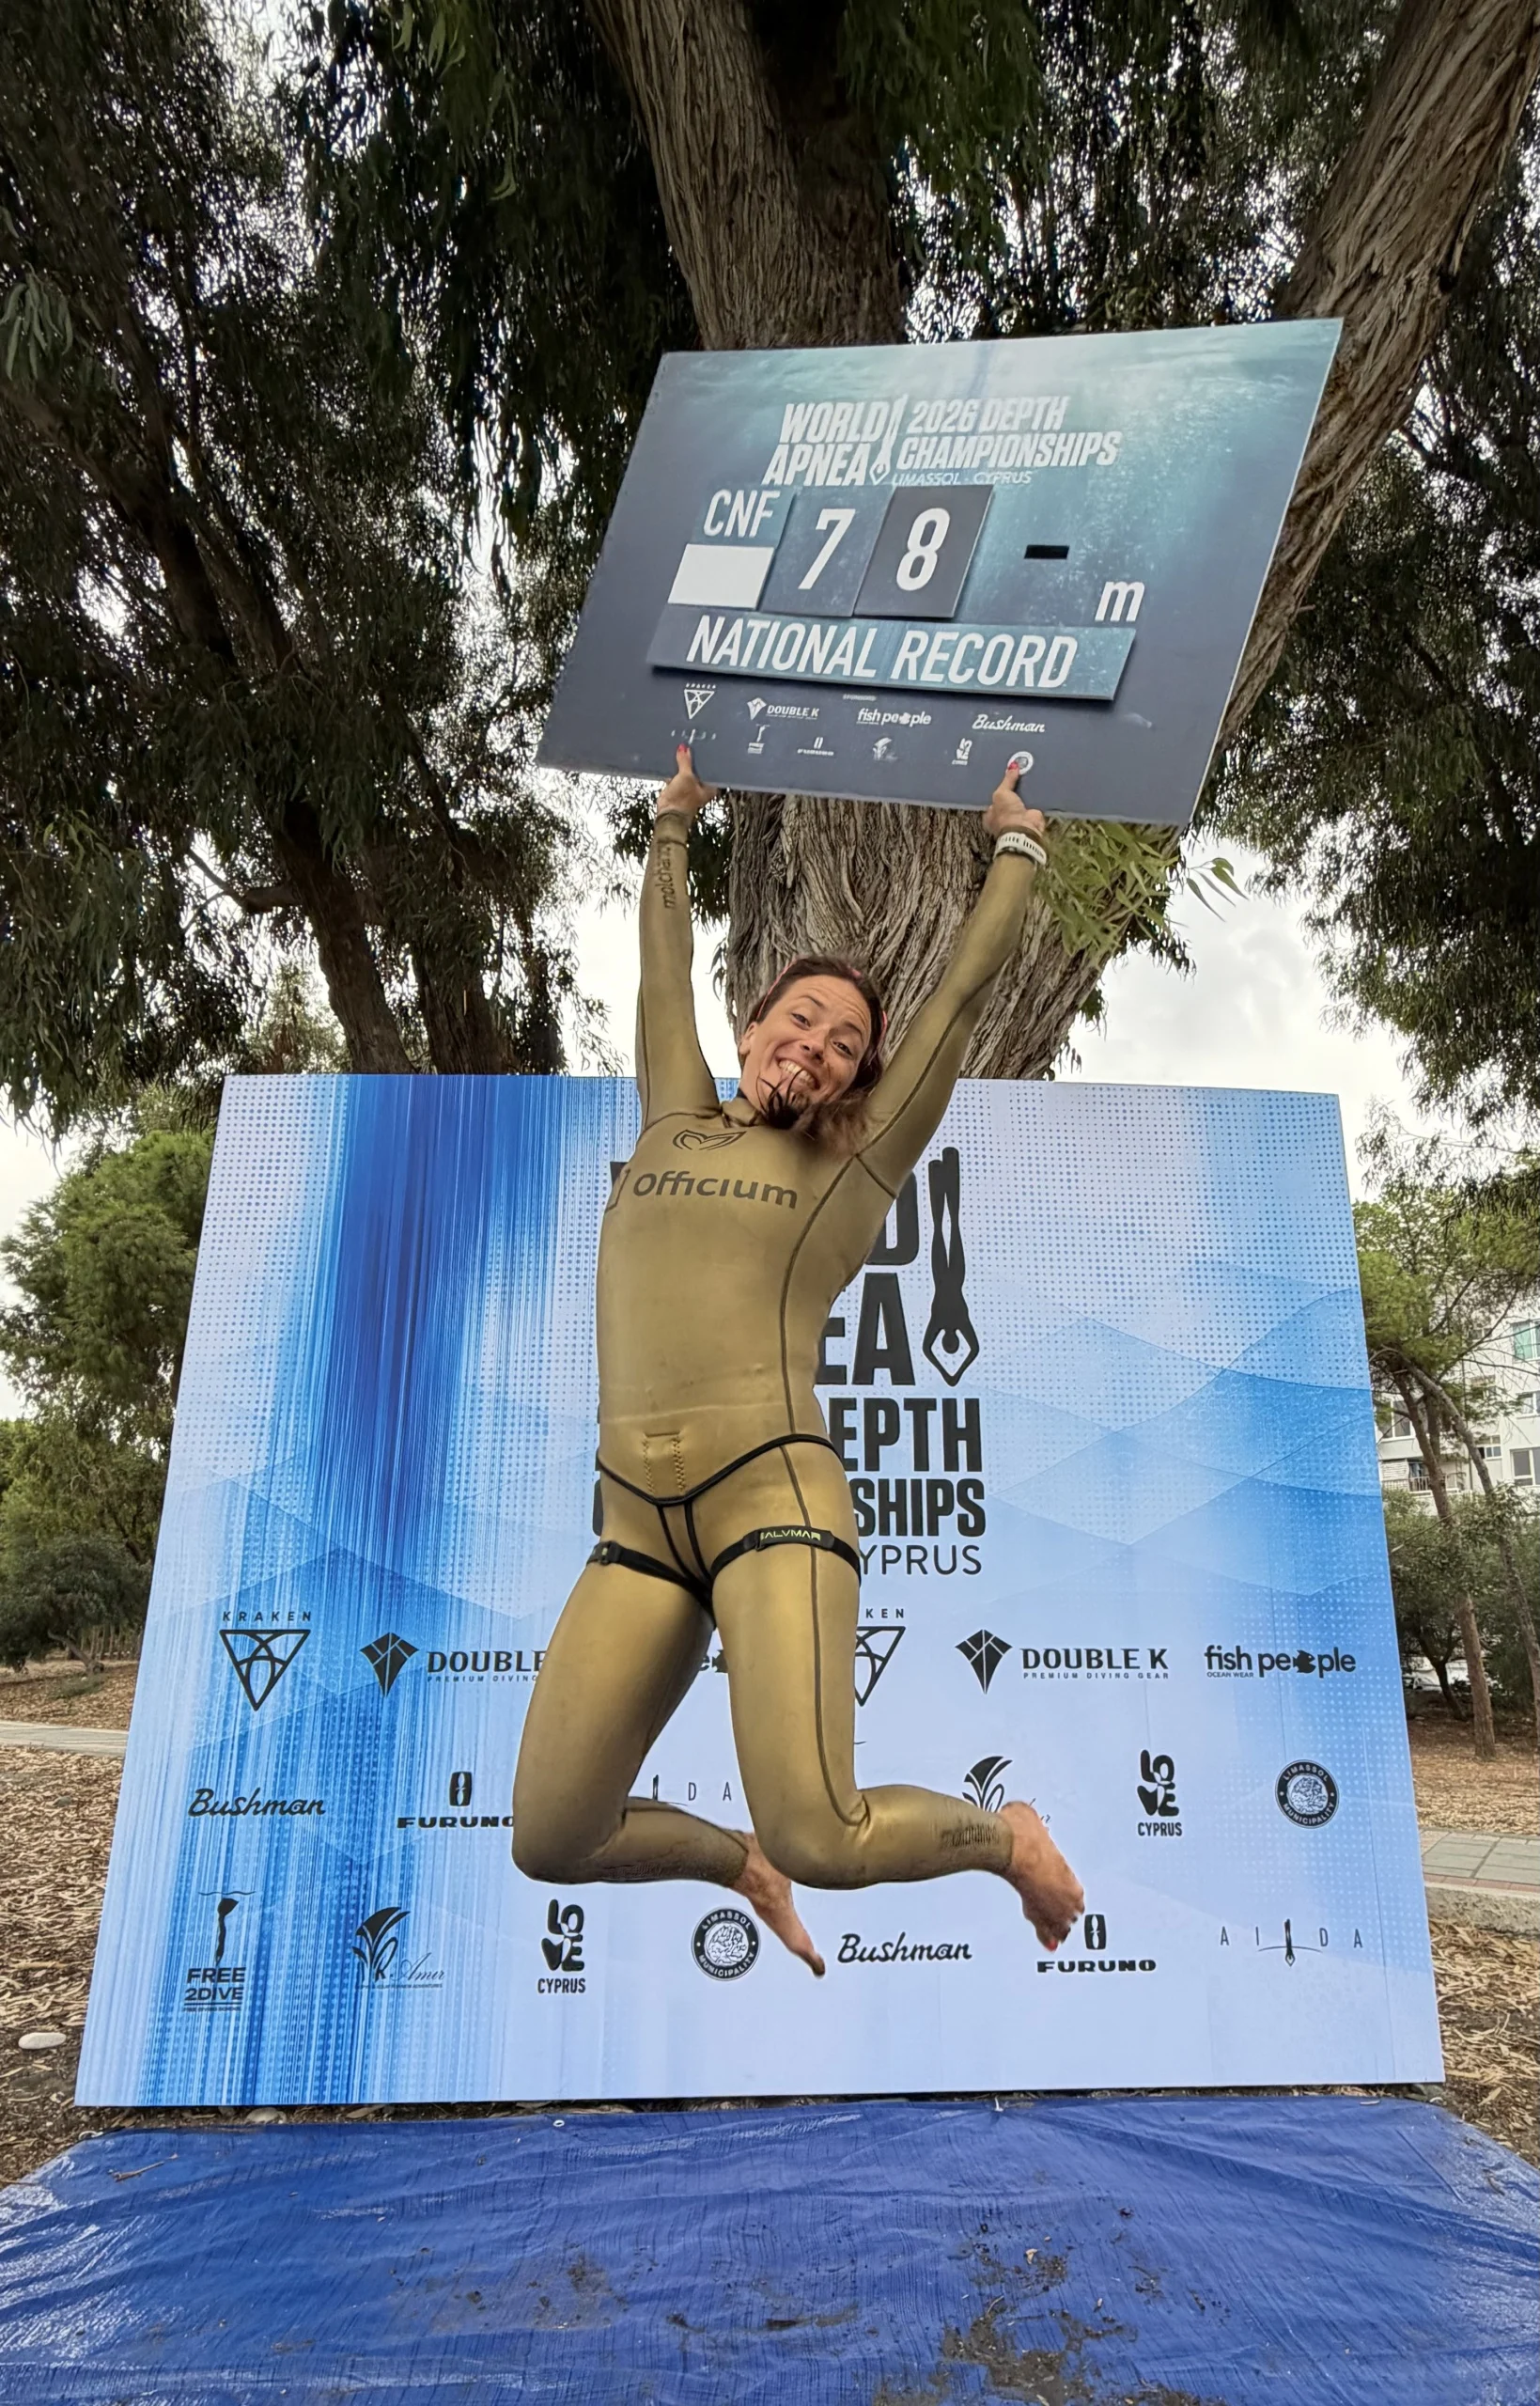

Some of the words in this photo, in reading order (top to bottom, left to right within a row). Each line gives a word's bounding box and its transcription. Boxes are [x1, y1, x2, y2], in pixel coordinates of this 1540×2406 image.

[779, 401, 889, 443] WORLD
[907, 398, 978, 434] 2026
[978, 396, 1070, 432] DEPTH
[896, 430, 1122, 470] CHAMPIONSHIPS
[761, 443, 872, 486] APNEA
[892, 472, 960, 486] LIMASSOL
[973, 470, 1033, 485] CYPRUS
[703, 489, 781, 539] CNF
[1095, 580, 1144, 622] m
[685, 615, 878, 680] NATIONAL
[890, 630, 1079, 688] RECORD
[767, 705, 810, 717] DOUBLE
[811, 707, 820, 718] K
[857, 708, 881, 724] fish
[972, 713, 1046, 733] Bushman
[829, 1398, 983, 1472] EPTH
[860, 1544, 982, 1575] YPRUS
[223, 1610, 312, 1623] KRAKEN
[1019, 1648, 1140, 1669] DOUBLE
[1146, 1648, 1169, 1669] K
[1204, 1645, 1252, 1670] fish
[1283, 1764, 1329, 1782] LIMASSOL
[188, 1787, 326, 1818] Bushman
[1283, 1802, 1334, 1825] MUNICIPALITY
[1137, 1821, 1183, 1837] CYPRUS
[702, 1911, 751, 1929] LIMASSOL
[837, 1931, 972, 1962] Bushman
[187, 1967, 246, 1983] FREE
[699, 1951, 754, 1977] MUNICIPALITY
[1037, 1960, 1157, 1973] FURUNO
[185, 1986, 243, 2001] 2DIVE
[537, 1977, 586, 1994] CYPRUS
